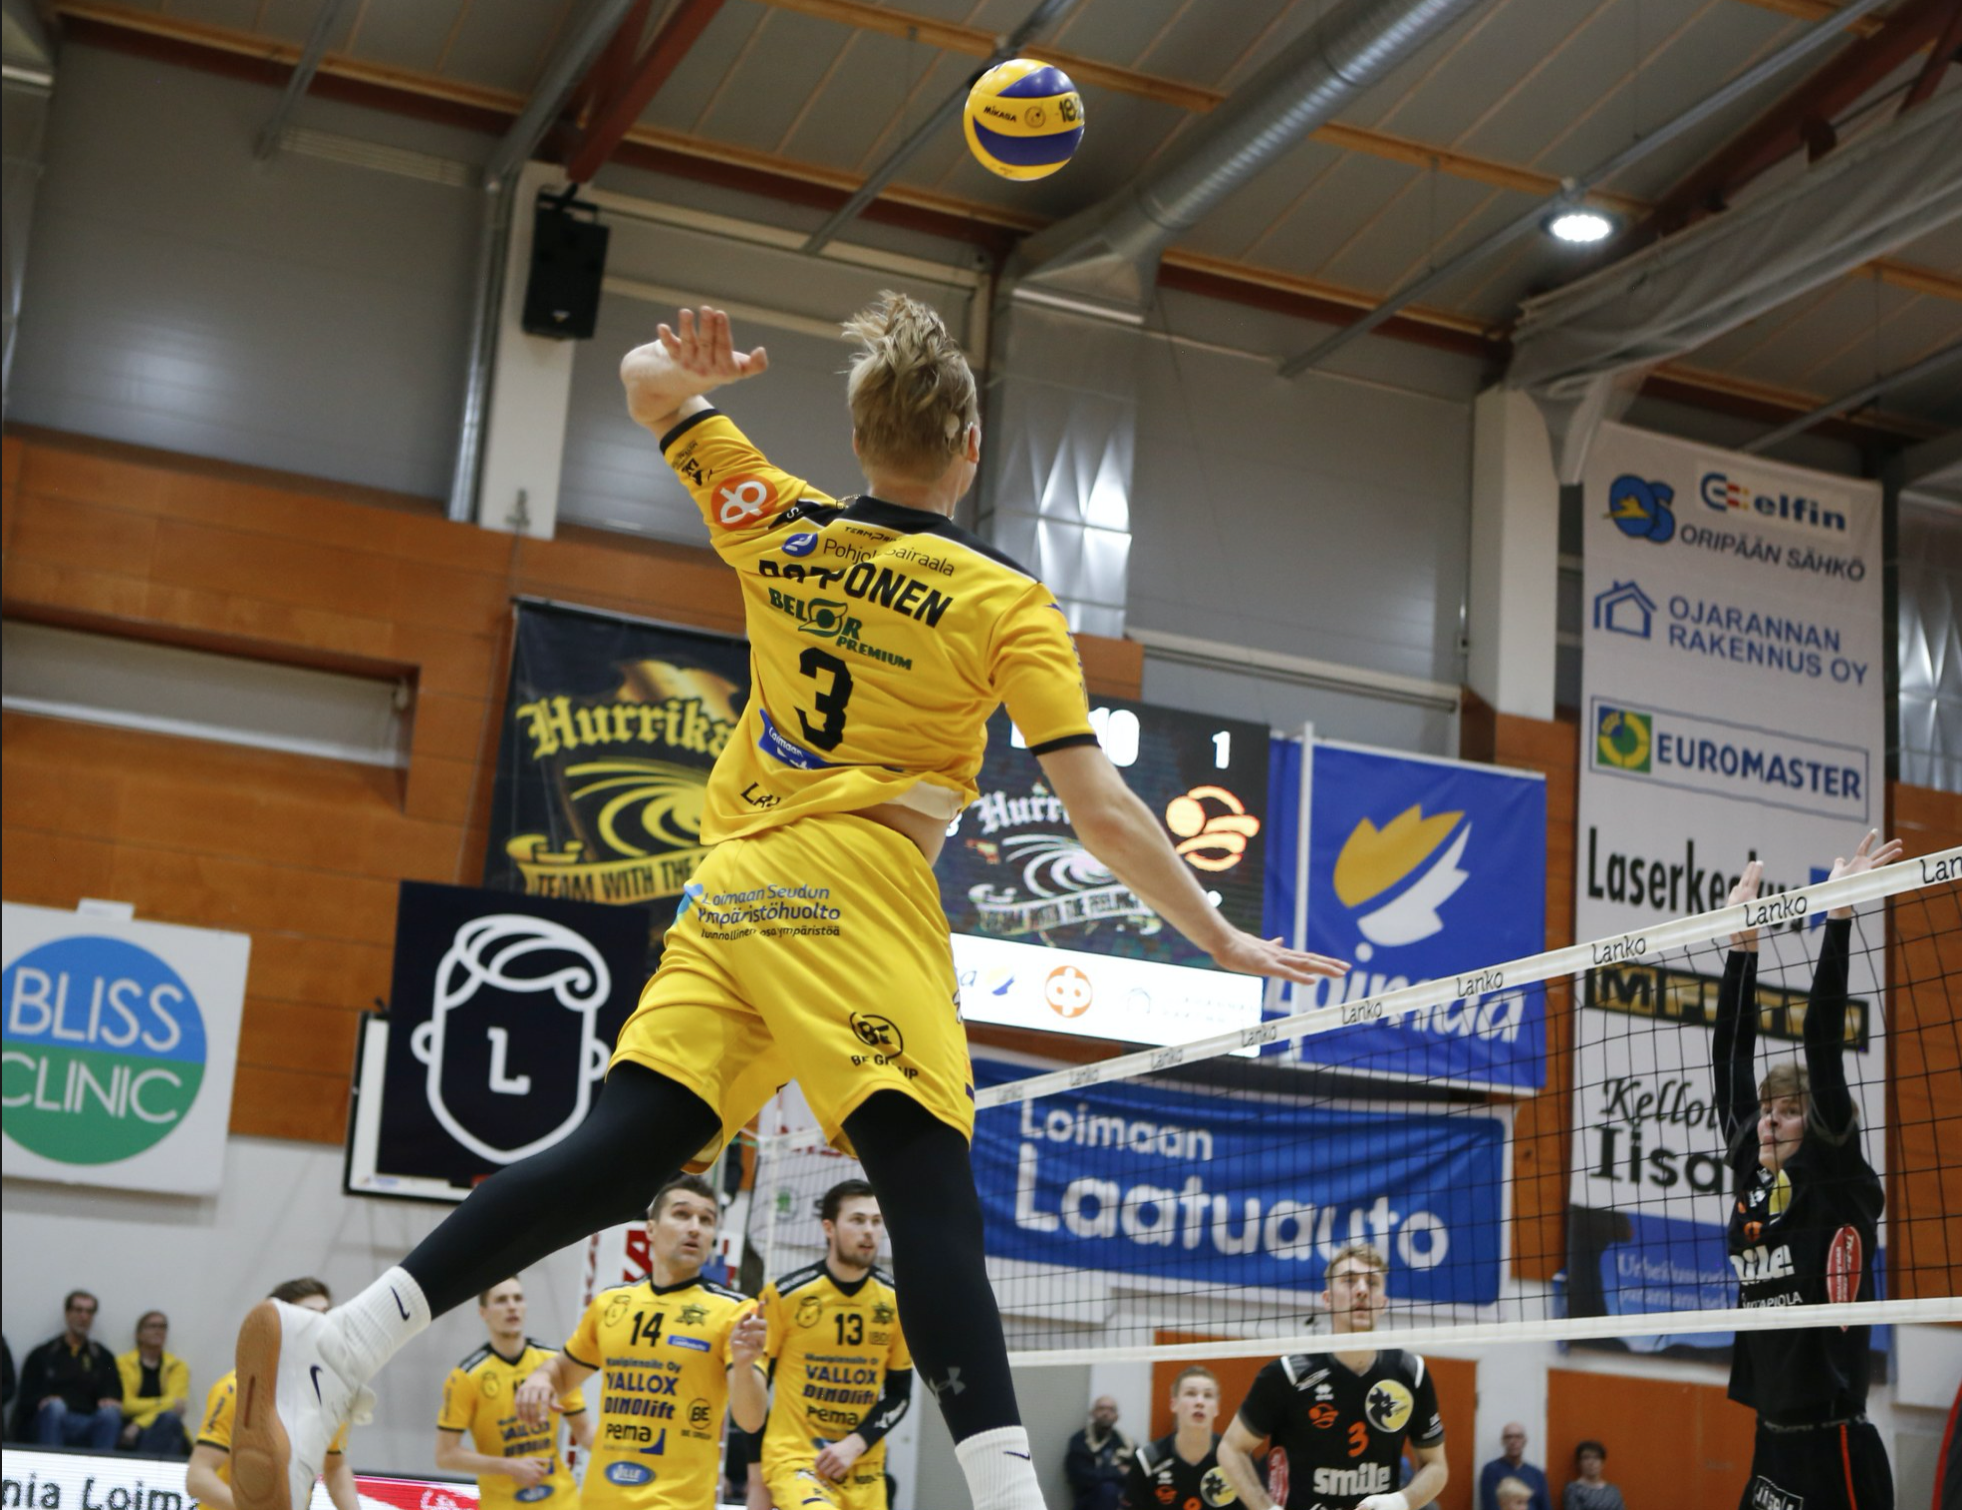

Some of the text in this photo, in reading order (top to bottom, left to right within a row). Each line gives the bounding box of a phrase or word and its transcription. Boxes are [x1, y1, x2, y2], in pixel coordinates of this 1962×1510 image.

[983, 106, 1017, 123] MIKASA
[1754, 493, 1846, 531] elfin
[1680, 523, 1866, 582] ORIPÄÄN SÄHKÖ
[1668, 595, 1841, 653] OJARANNAN
[836, 634, 913, 671] PREMIUM
[1668, 624, 1868, 686] RAKENNUS OY
[793, 647, 853, 752] 3
[1212, 730, 1230, 769] 1
[1656, 732, 1862, 803] EUROMASTER
[538, 858, 691, 901] TEAM WITH THE
[701, 884, 829, 906] Loimaan Seudun
[698, 901, 841, 929] Ympäristöhuolto
[1744, 894, 1808, 928] Lanko
[1591, 935, 1647, 965] Lanko
[1456, 970, 1504, 998] Lanko
[9, 967, 184, 1053] BLISS
[1341, 1000, 1383, 1025] Lanko
[1240, 1025, 1277, 1048] Lanko
[1151, 1048, 1183, 1069] Lanko
[1, 1052, 182, 1123] CLINIC
[1020, 1100, 1213, 1161] Loimaan
[1589, 1124, 1738, 1197] Iisa
[1015, 1143, 1449, 1271] Laatuauto
[630, 1311, 664, 1347] 14
[835, 1313, 863, 1346] 13
[605, 1372, 679, 1396] VALLOX
[805, 1364, 877, 1385] VALLOX
[1348, 1421, 1370, 1457] 3
[1, 1472, 198, 1510] nia Loim
[1313, 1462, 1391, 1496] smile
